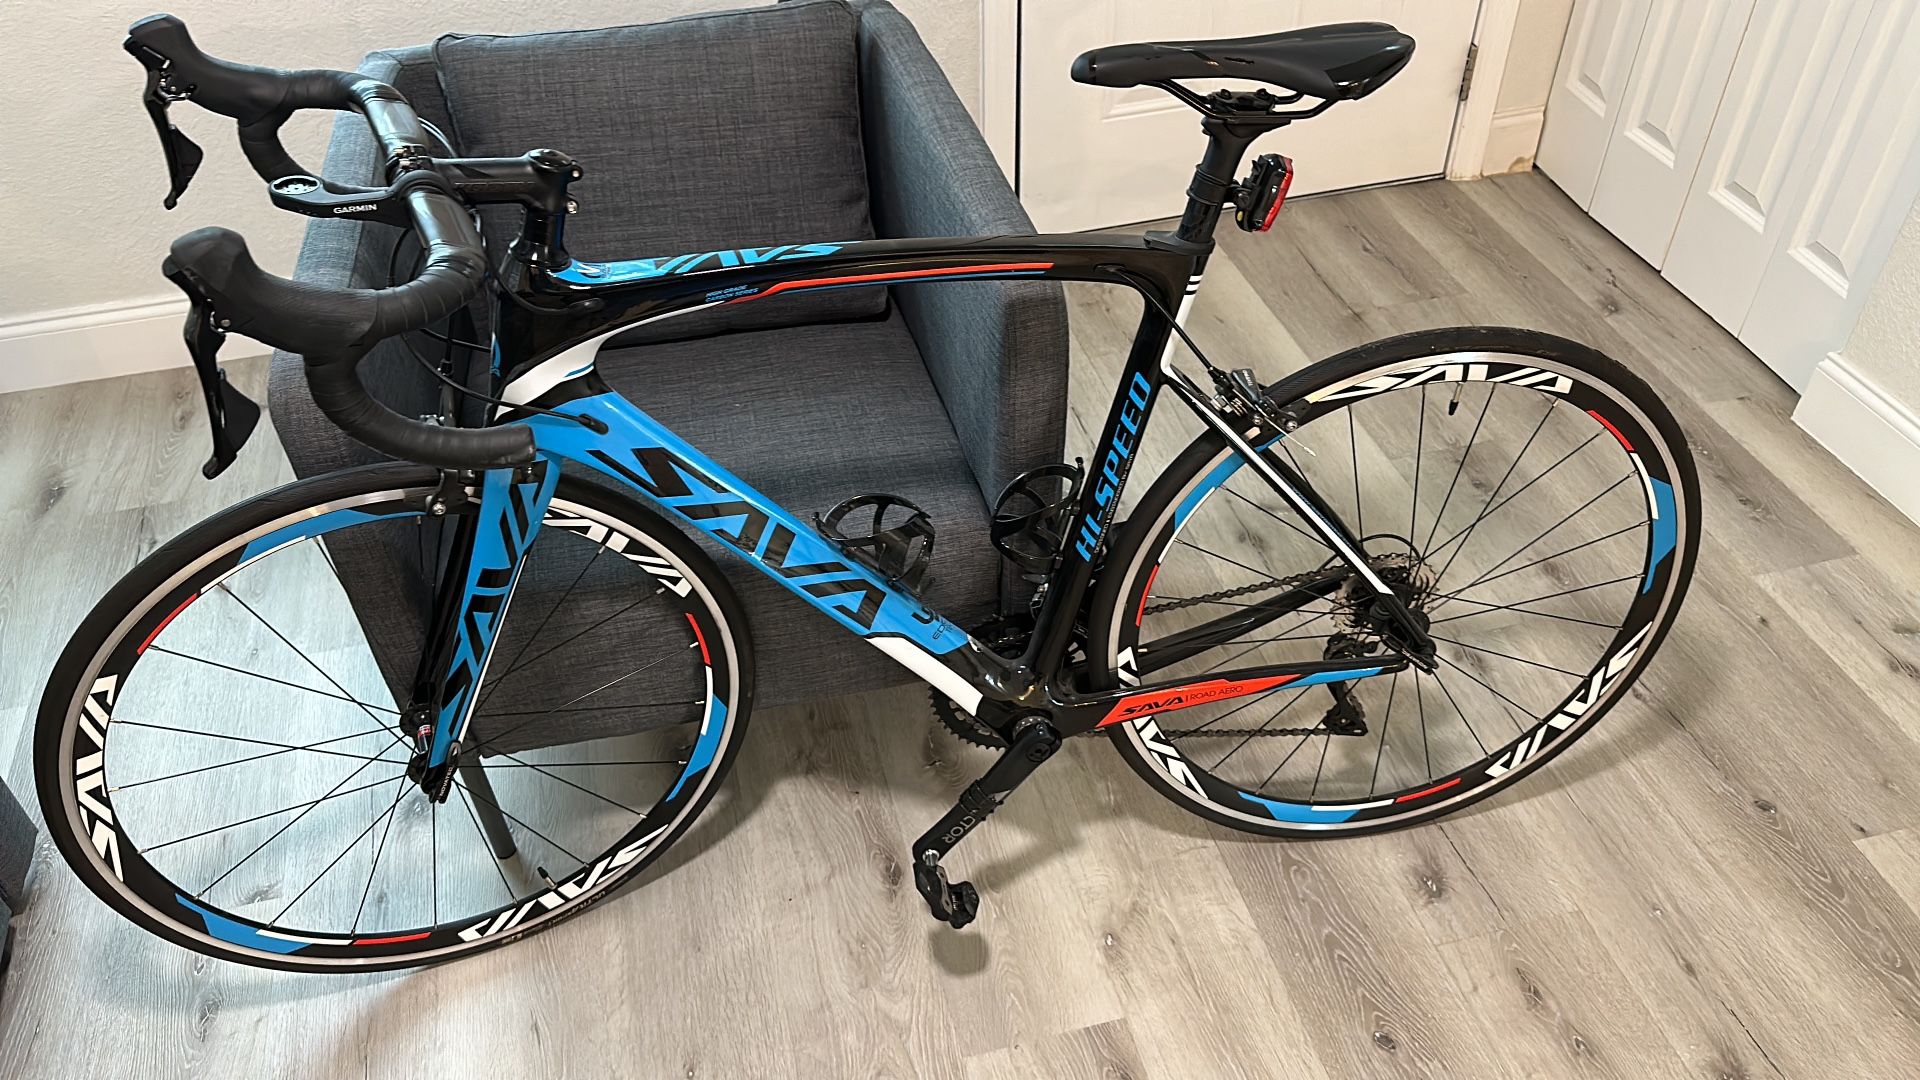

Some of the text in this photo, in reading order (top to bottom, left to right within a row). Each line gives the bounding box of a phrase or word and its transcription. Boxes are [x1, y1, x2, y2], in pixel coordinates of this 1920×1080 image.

[333, 203, 378, 214] GARMIN
[1304, 363, 1574, 404] SAVA
[1075, 371, 1152, 562] HI-SPEED
[441, 459, 550, 738] SAVA
[541, 505, 693, 598] AVA
[586, 447, 887, 631] SAVA
[1118, 685, 1244, 717] SAVA ROAD AERO
[1485, 621, 1653, 779] SAVA
[75, 674, 124, 883] SAVA
[457, 823, 669, 942] SAVA
